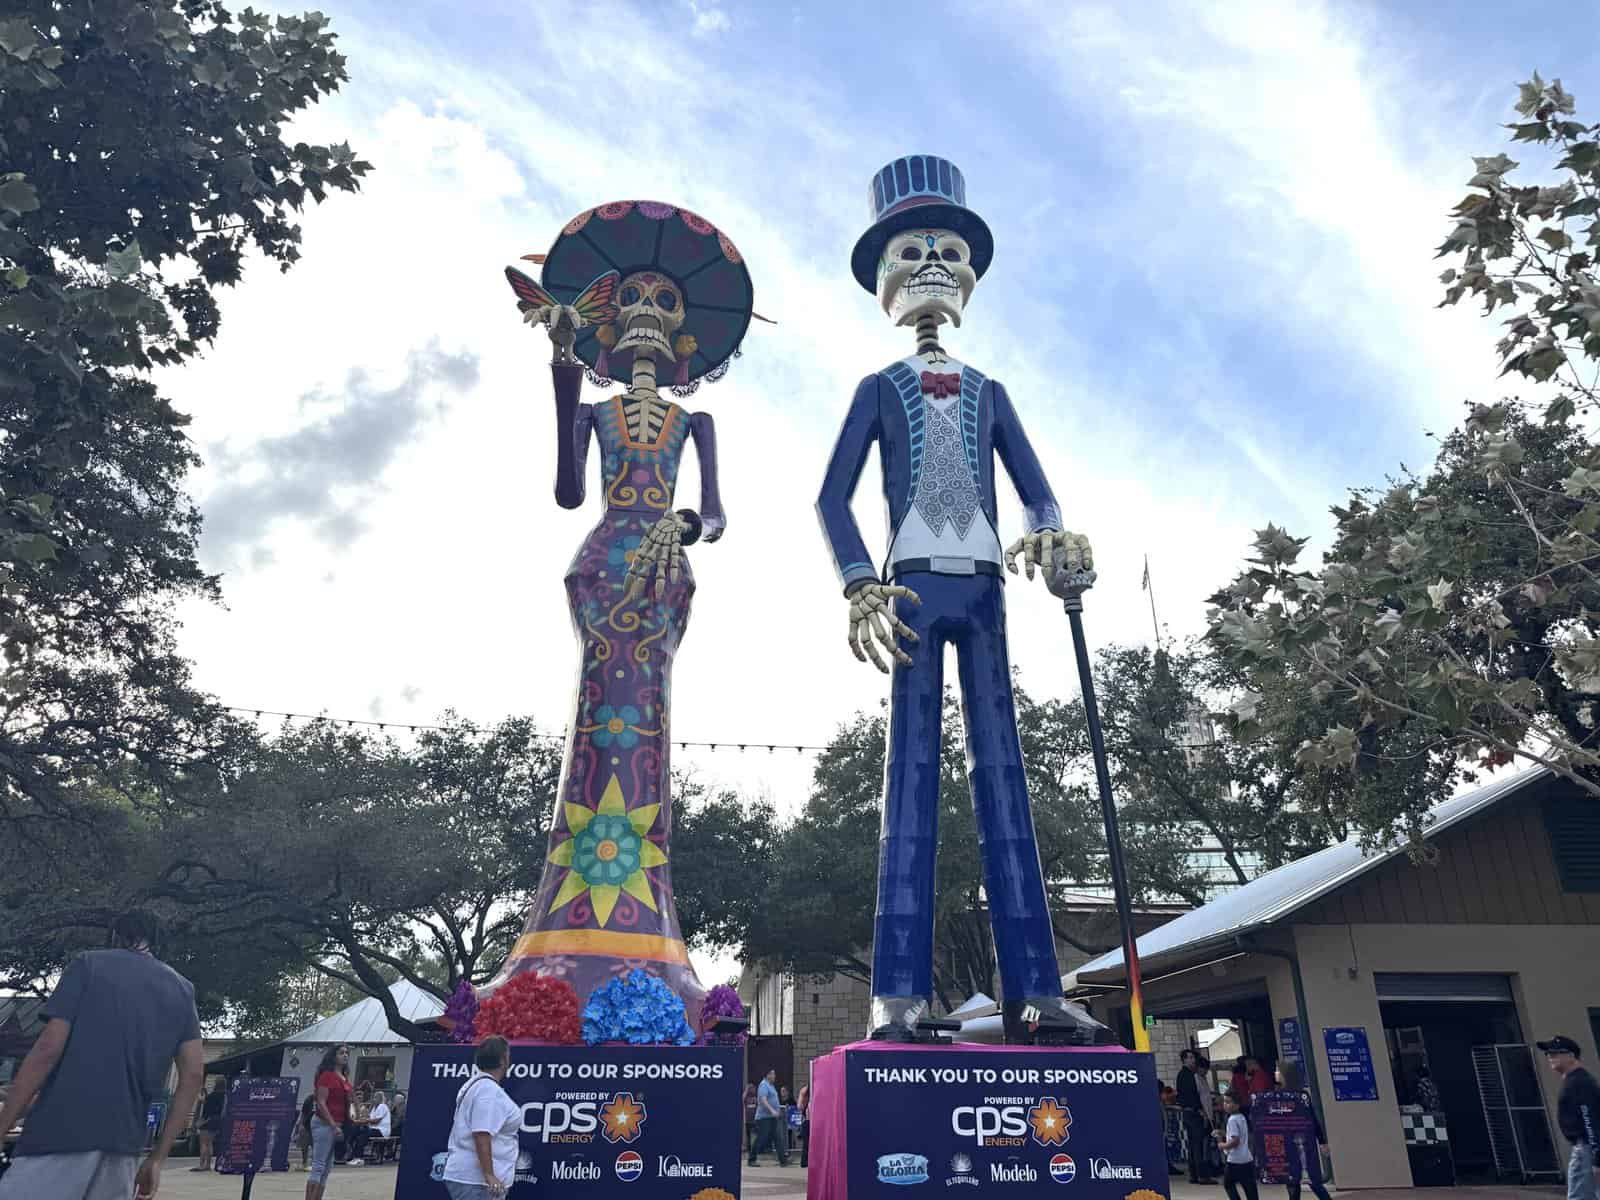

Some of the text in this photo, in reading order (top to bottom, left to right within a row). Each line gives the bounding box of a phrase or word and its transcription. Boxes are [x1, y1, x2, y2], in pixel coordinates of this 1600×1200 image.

[504, 1063, 542, 1078] YOU
[547, 1063, 573, 1078] TO
[577, 1063, 618, 1079] OUR
[622, 1063, 723, 1079] SPONSORS
[864, 1068, 1138, 1084] THANK YOU TO OUR SPONSORS
[555, 1092, 610, 1100] POWERED BY
[984, 1096, 1035, 1105] POWERED BY
[518, 1102, 598, 1143] cps
[951, 1106, 1028, 1146] cps
[550, 1134, 595, 1144] ENERGY
[985, 1137, 1027, 1147] ENERGY
[551, 1160, 601, 1181] Modelo
[616, 1161, 642, 1170] PEPSI
[681, 1165, 713, 1177] NOBLE
[1051, 1164, 1074, 1173] PEPSI
[880, 1166, 925, 1177] GLORIA
[991, 1163, 1037, 1182] Modelo
[1111, 1168, 1142, 1179] NOBLE
